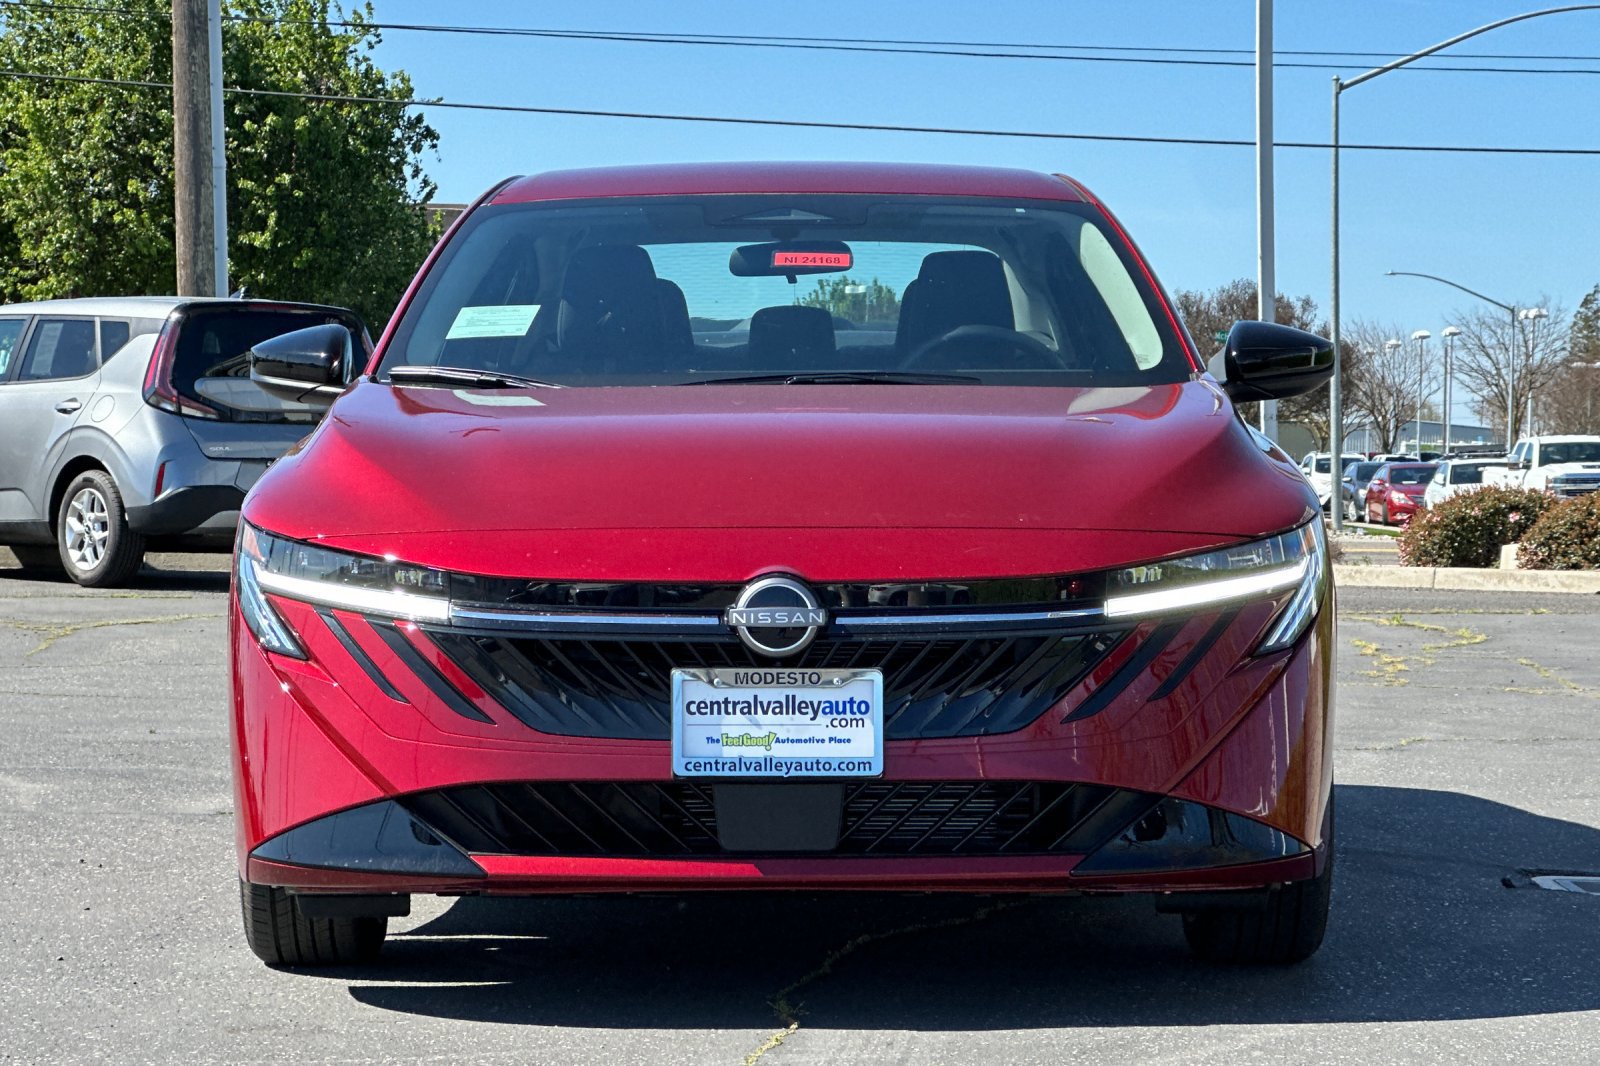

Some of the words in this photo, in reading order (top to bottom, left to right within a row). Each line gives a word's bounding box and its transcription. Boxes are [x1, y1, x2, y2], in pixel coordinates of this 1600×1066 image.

[784, 256, 798, 264] NI
[802, 256, 841, 264] 24168
[732, 612, 823, 624] NISSAN
[734, 671, 822, 685] MODESTO
[685, 694, 870, 721] centralvalleyauto
[825, 717, 865, 728] .com
[706, 736, 721, 744] The
[774, 736, 826, 744] Automotive
[828, 736, 852, 744] Place
[684, 756, 872, 776] centralvalleyauto.com
